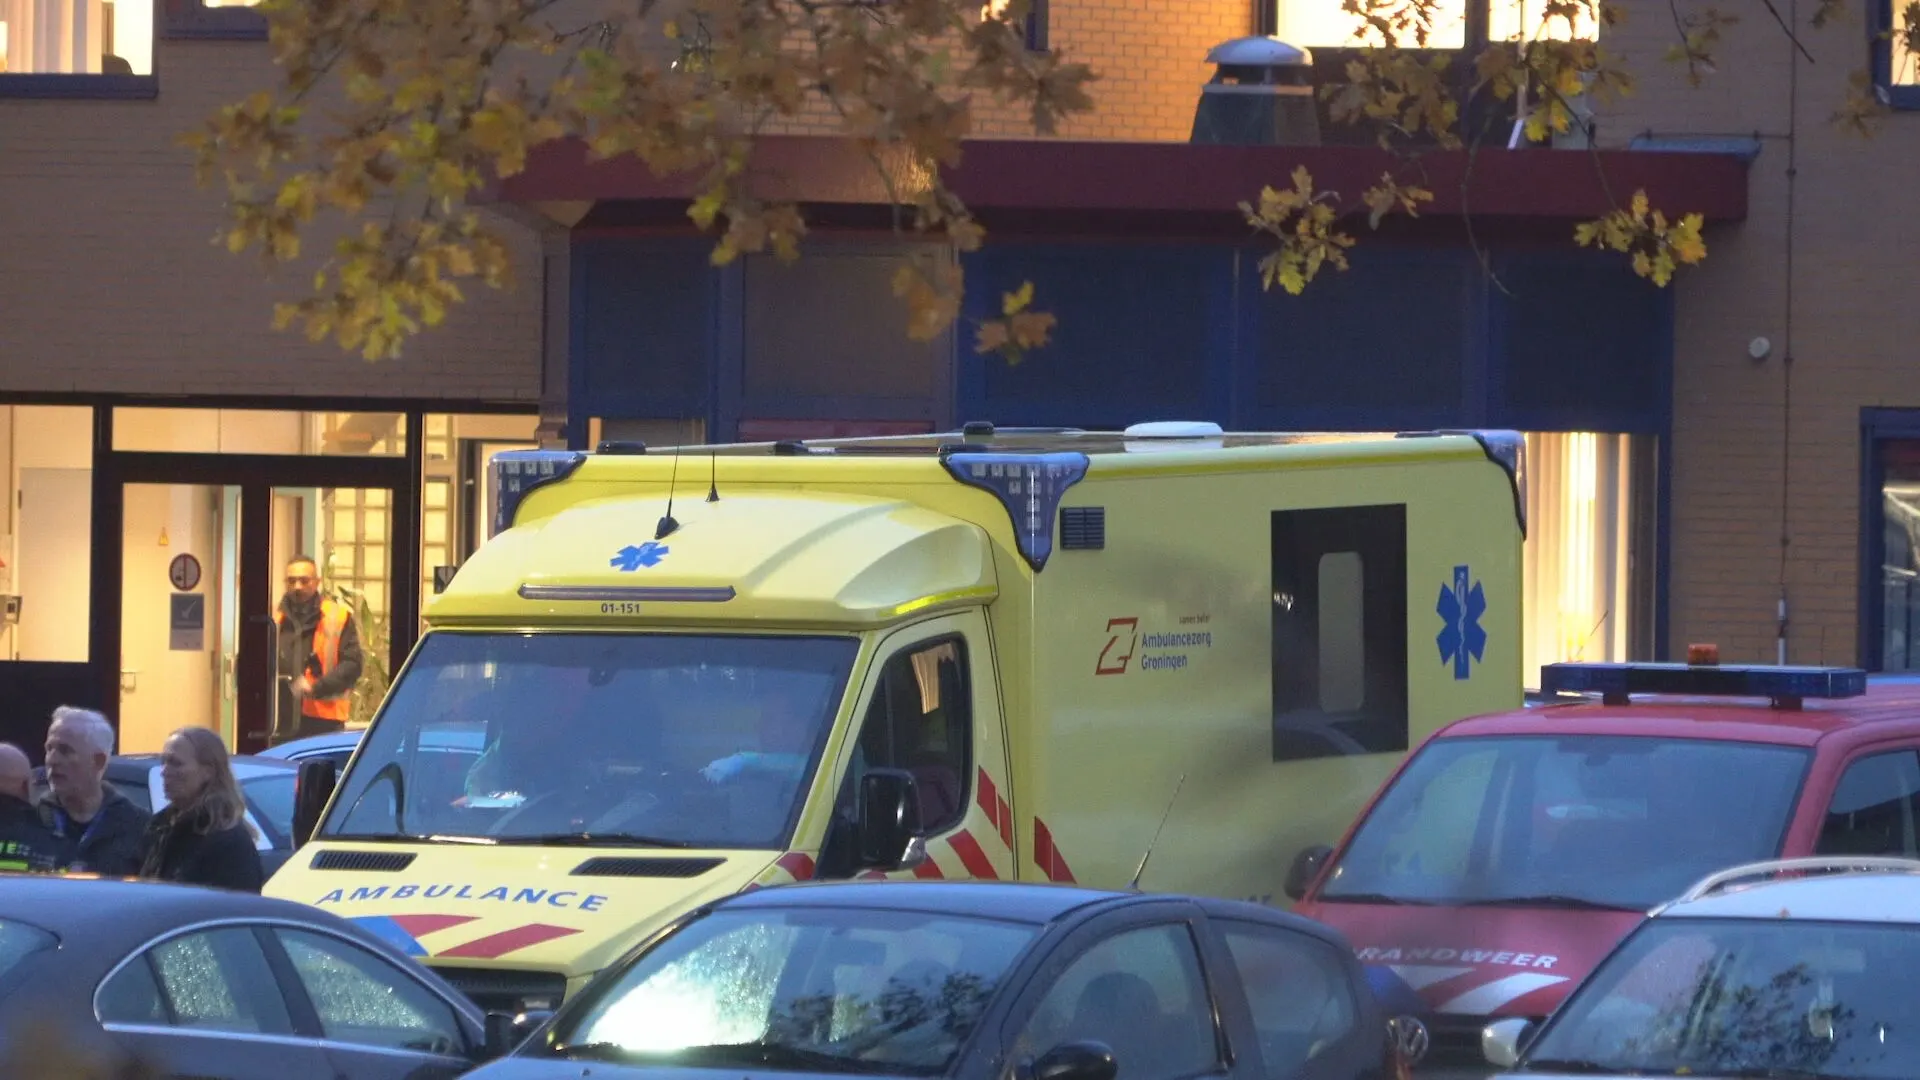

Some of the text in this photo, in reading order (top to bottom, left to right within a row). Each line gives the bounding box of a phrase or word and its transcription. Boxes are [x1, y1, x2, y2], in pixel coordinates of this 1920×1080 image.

[601, 603, 640, 613] 01-151
[1142, 632, 1212, 648] Ambulancezorg
[1141, 654, 1188, 671] Groningen
[314, 884, 608, 912] AMBULANCE
[1354, 947, 1558, 968] RANDWEER
